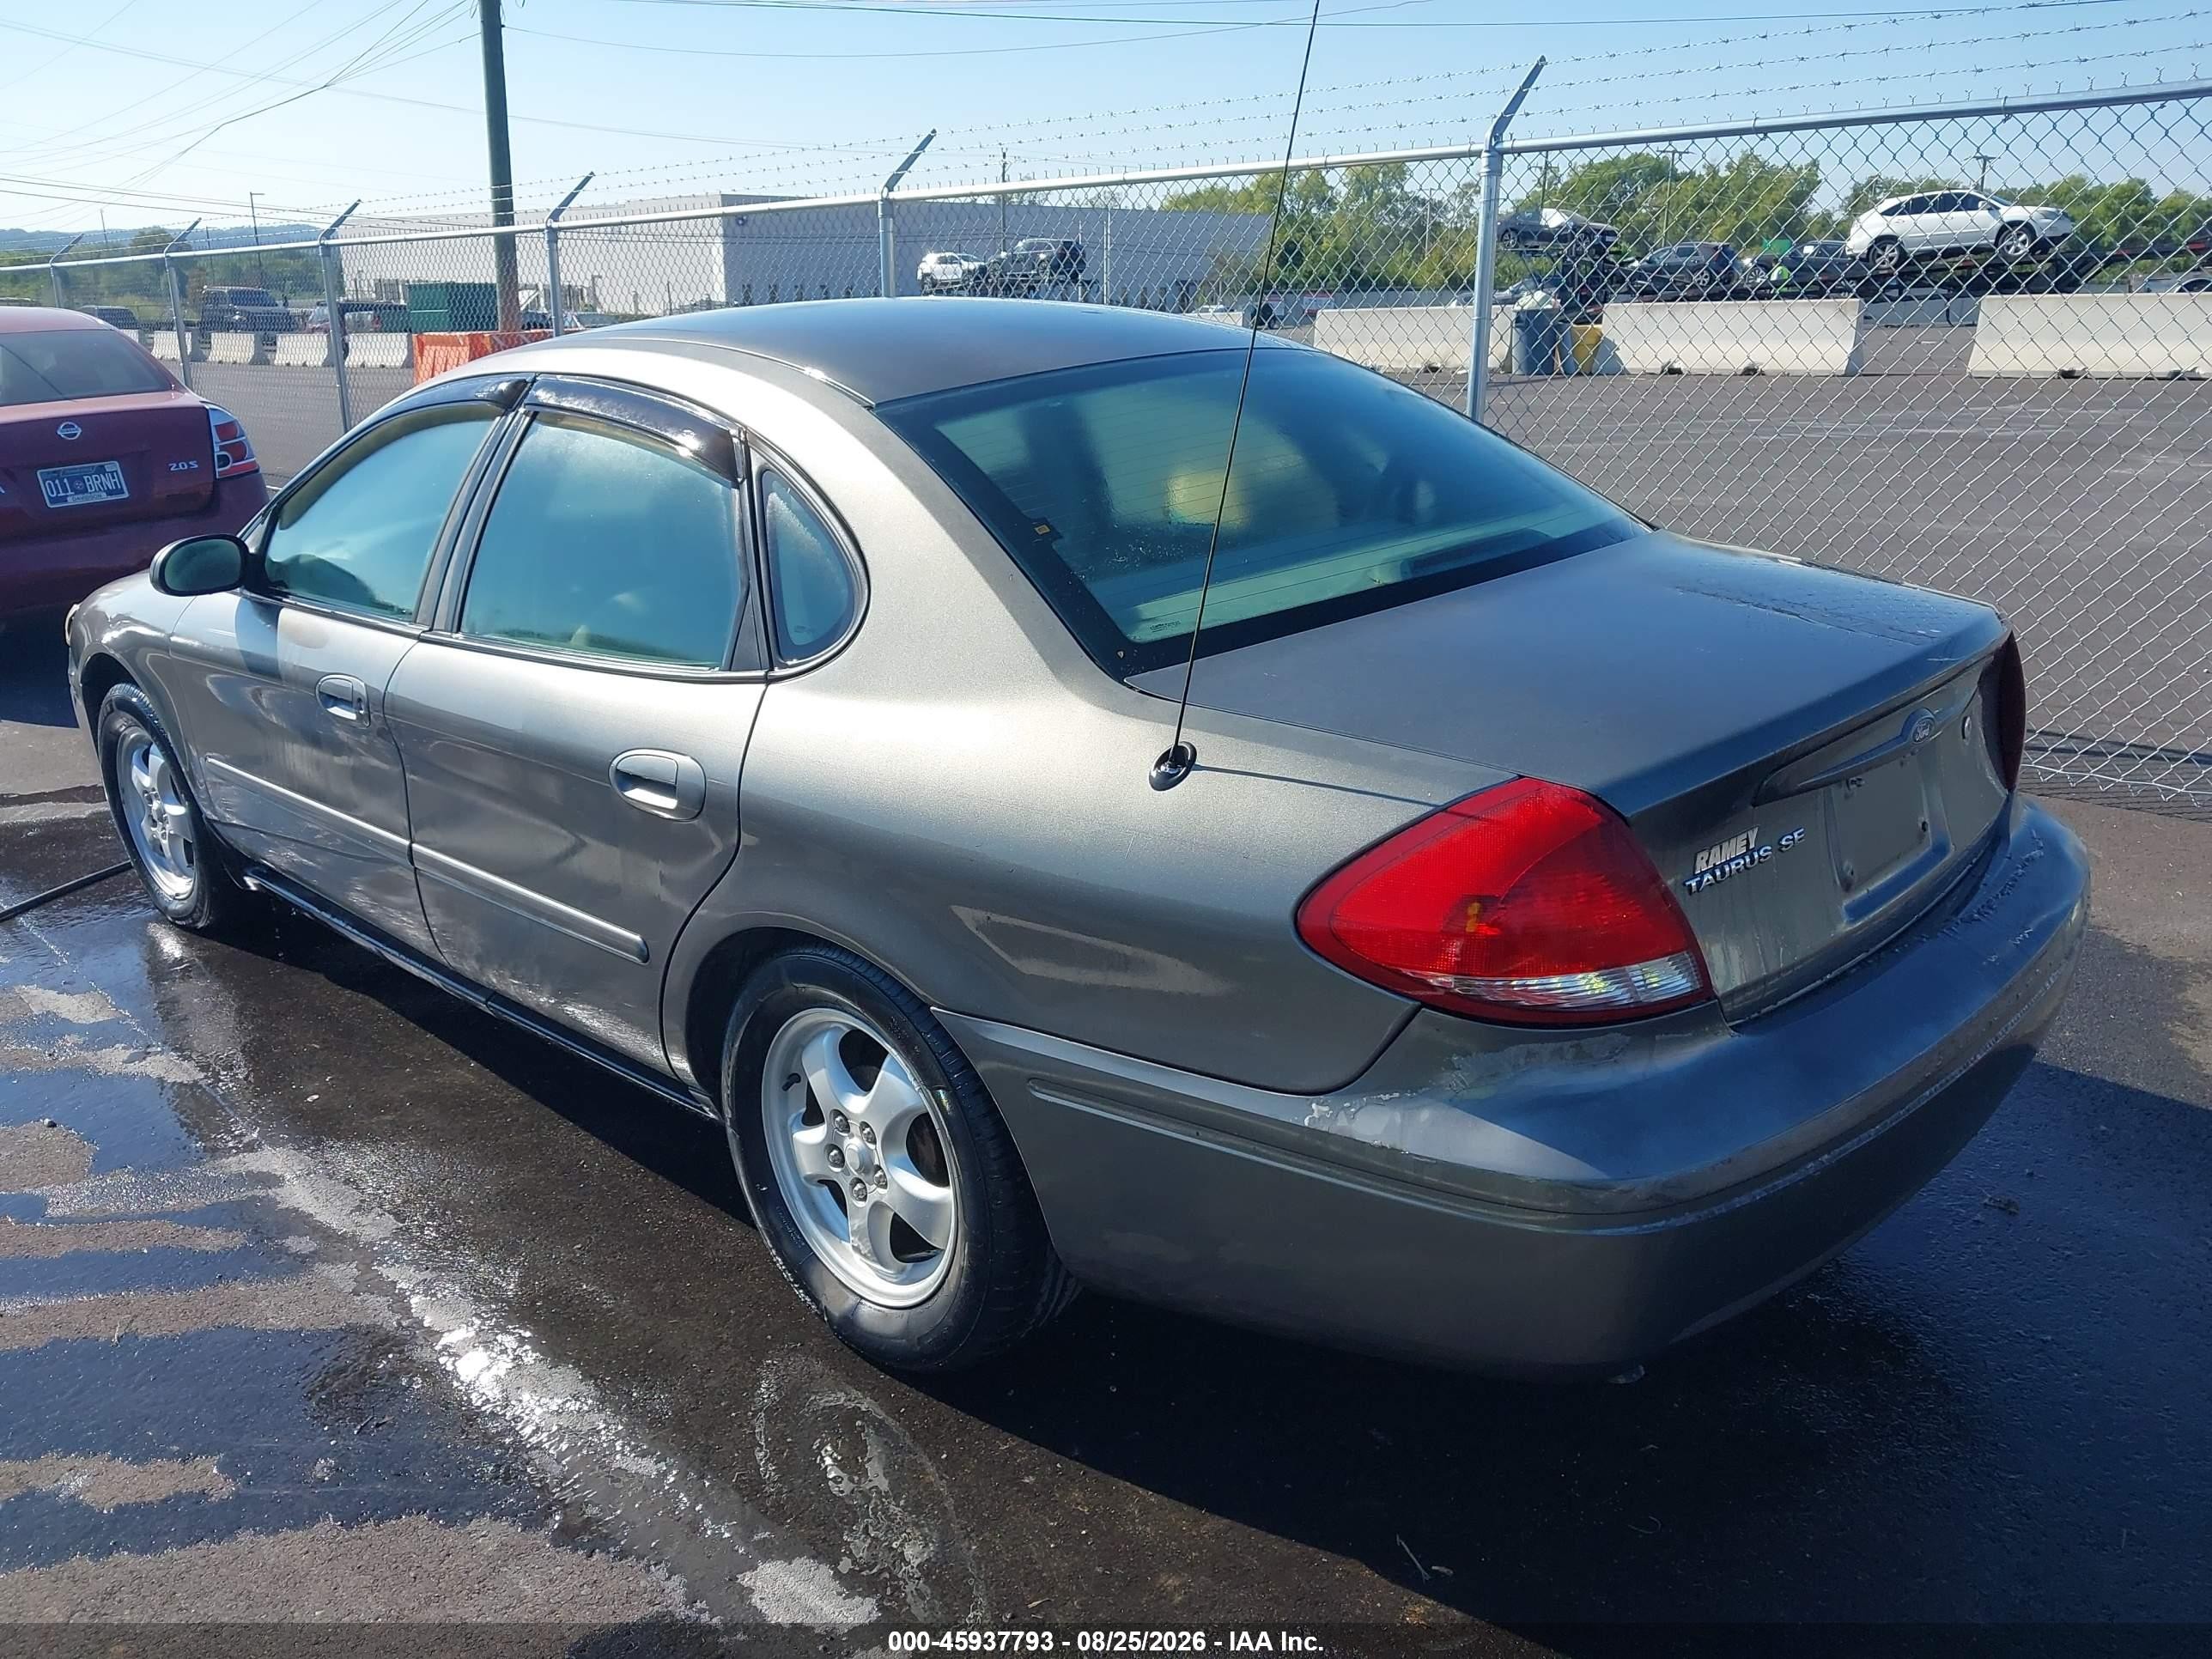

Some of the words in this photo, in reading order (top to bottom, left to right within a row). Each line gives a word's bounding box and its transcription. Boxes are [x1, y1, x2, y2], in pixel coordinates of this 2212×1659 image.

[45, 477, 76, 498] 011
[82, 471, 122, 493] BRNH
[1683, 845, 1773, 894] TAURUS
[1778, 828, 1806, 852] SE
[1694, 826, 1759, 875] RAMEY
